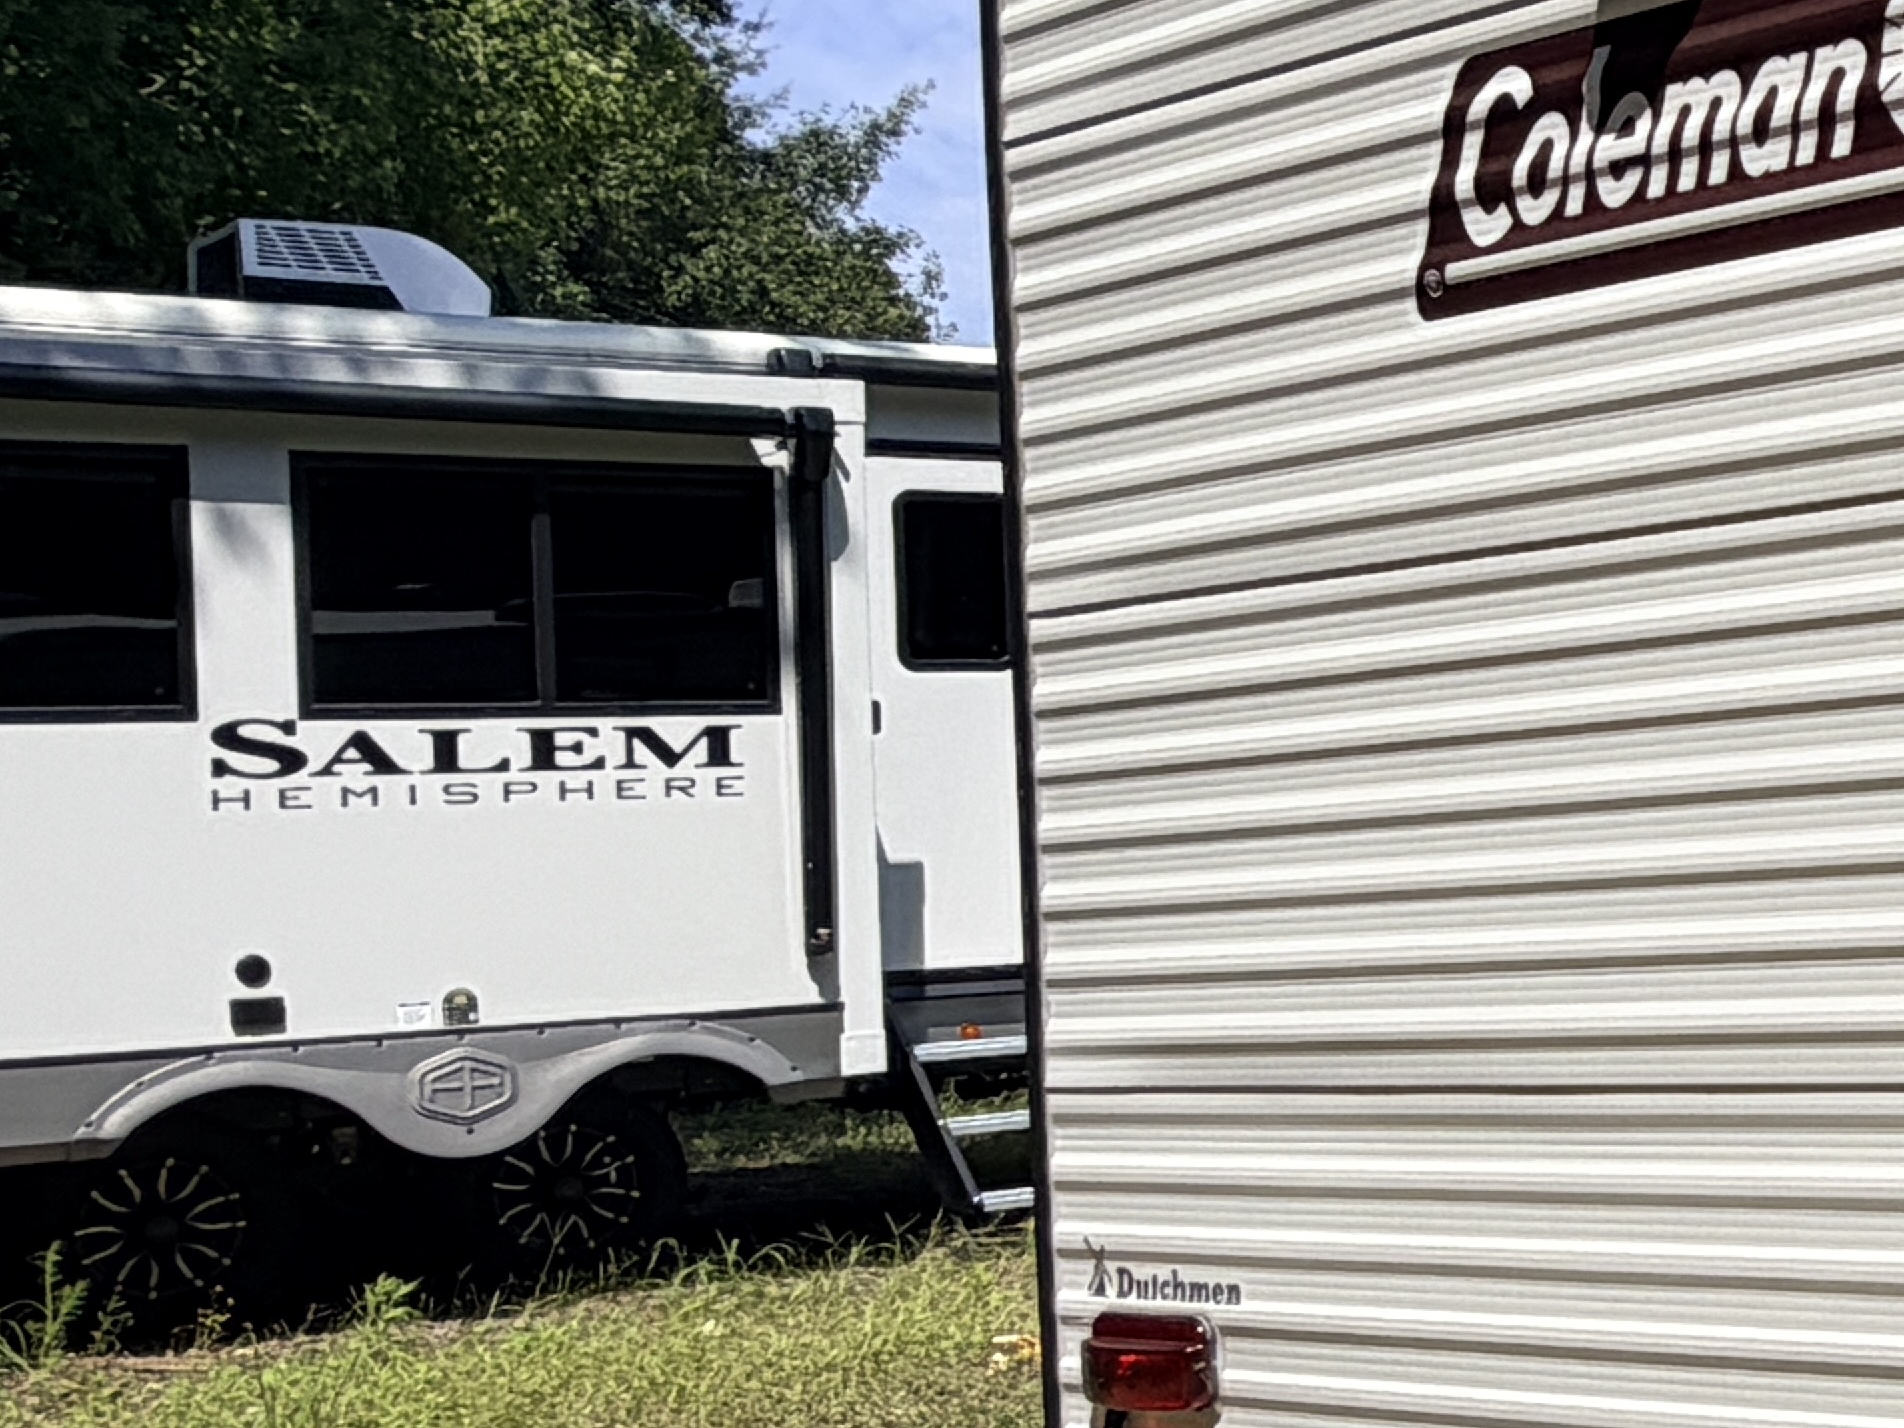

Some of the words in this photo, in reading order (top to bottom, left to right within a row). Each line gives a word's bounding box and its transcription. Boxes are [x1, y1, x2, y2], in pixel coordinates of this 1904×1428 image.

[1454, 38, 1867, 247] Coleman
[209, 718, 745, 780] SALEM
[210, 774, 745, 812] HEMISPHERE
[1116, 1266, 1242, 1306] Dutchmen
